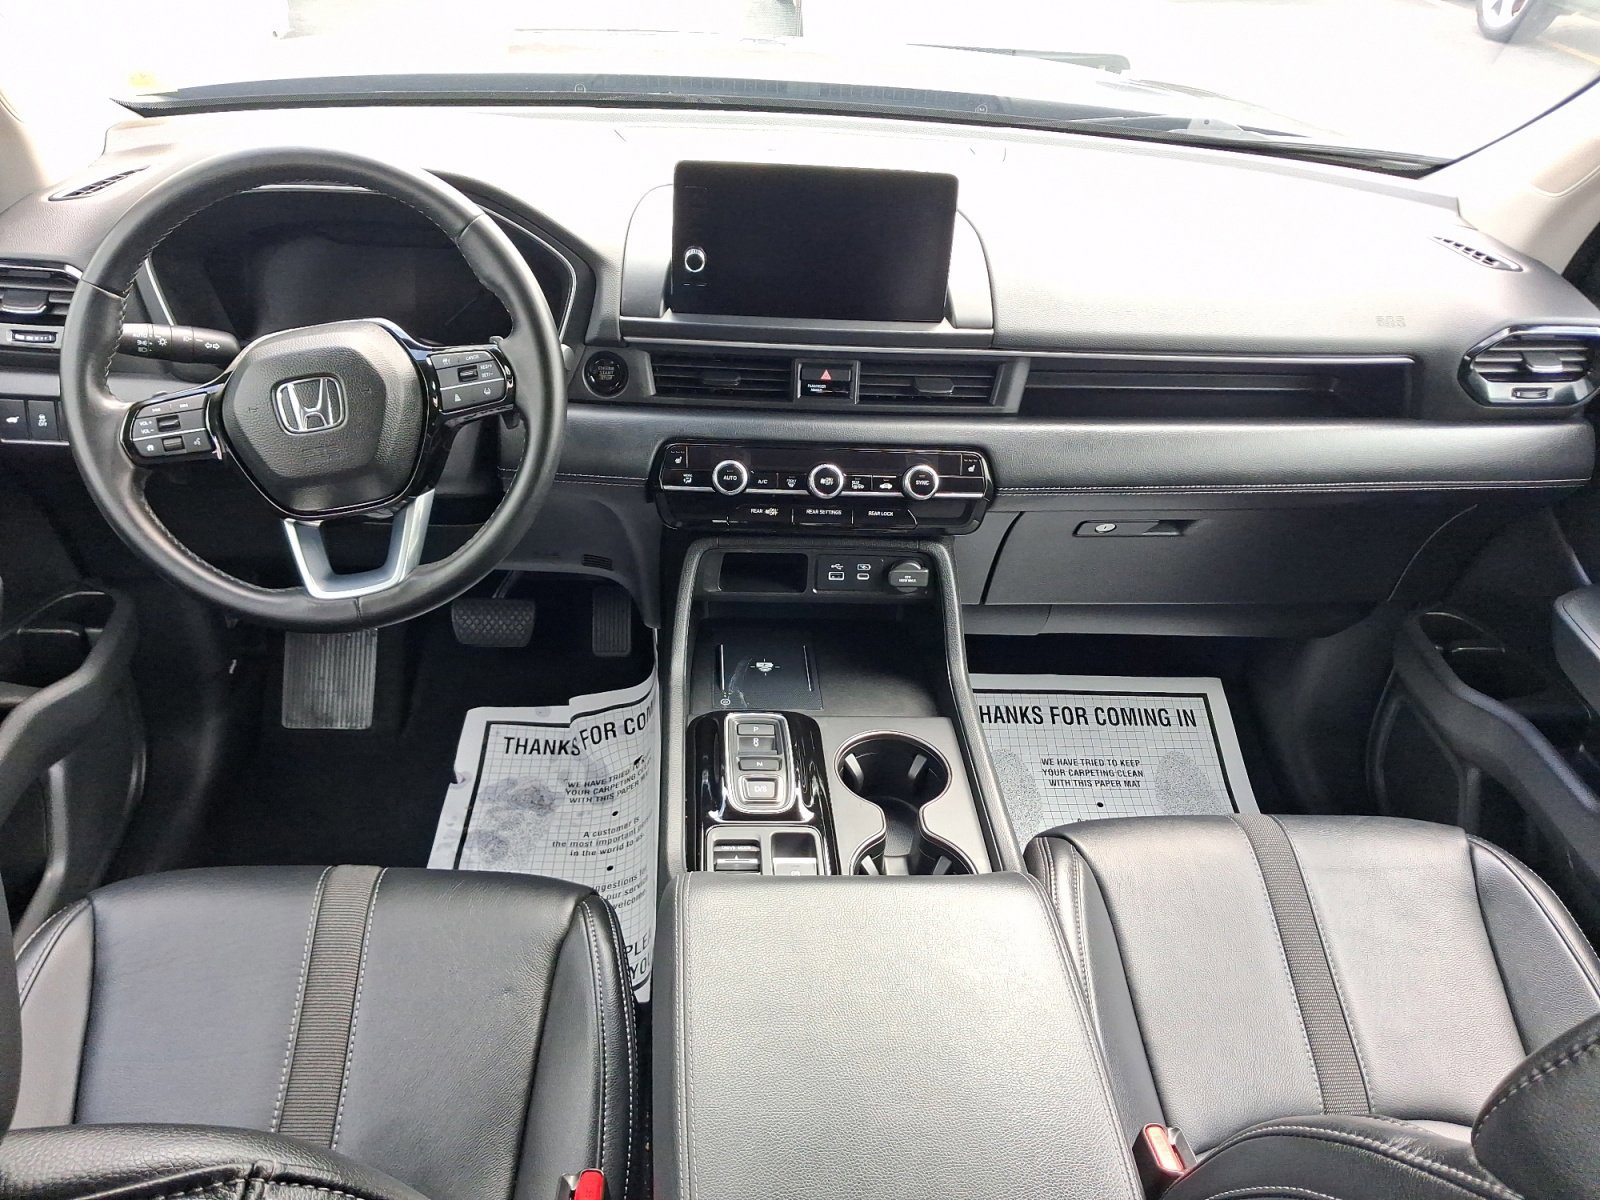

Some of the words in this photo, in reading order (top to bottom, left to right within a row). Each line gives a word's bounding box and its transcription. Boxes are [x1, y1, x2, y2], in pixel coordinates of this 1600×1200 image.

[979, 705, 1044, 725] HANKS
[1050, 706, 1089, 726] FOR
[1094, 707, 1171, 727] COMING
[1176, 709, 1197, 727] IN
[504, 736, 580, 756] THANKS
[580, 722, 616, 750] FOR
[1056, 758, 1078, 766] HAVE
[1080, 758, 1105, 767] TRIED
[1120, 760, 1140, 768] KEEP
[1042, 768, 1066, 776] YOUR
[1068, 768, 1115, 777] CARPETING
[1117, 770, 1144, 778] CLEAN
[566, 788, 590, 796] YOUR
[593, 774, 636, 796] CARPETING
[584, 778, 607, 788] HAVE
[1074, 779, 1092, 787] THIS
[1094, 780, 1122, 788] PAPER
[1124, 780, 1141, 788] MAT
[570, 796, 592, 804] WITH
[596, 792, 614, 802] THIS
[600, 842, 624, 854] world
